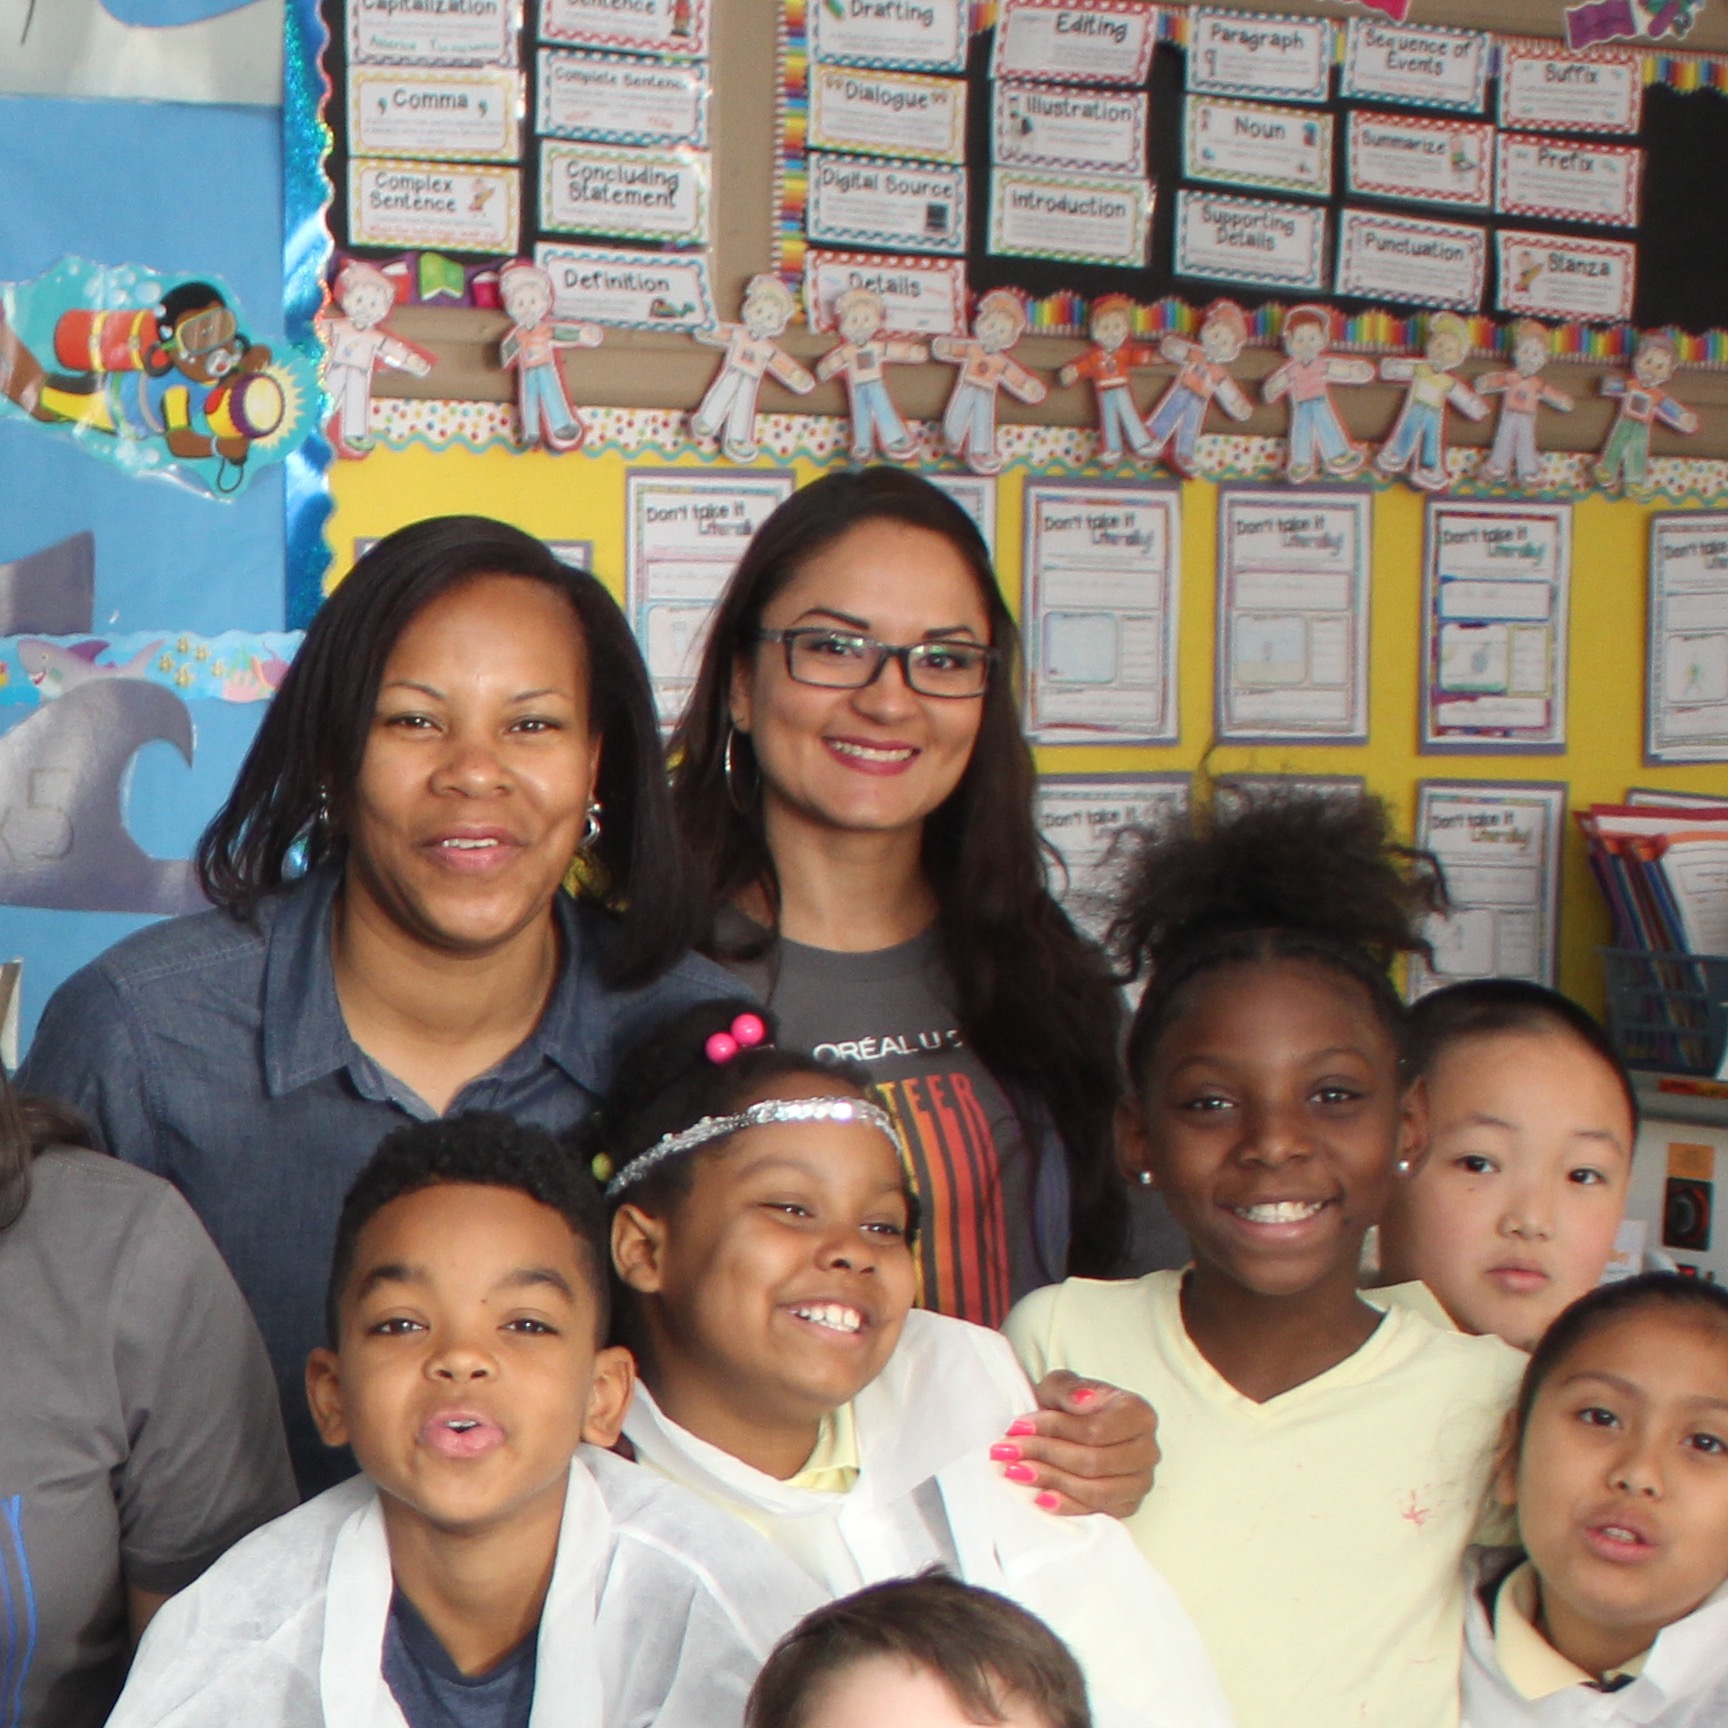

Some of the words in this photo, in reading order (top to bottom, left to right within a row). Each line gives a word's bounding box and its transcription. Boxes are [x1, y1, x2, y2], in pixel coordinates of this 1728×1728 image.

[1056, 12, 1128, 42] Editing
[1211, 23, 1304, 52] Paragraph
[1365, 29, 1448, 56] Sequence
[1456, 39, 1475, 58] of
[1386, 50, 1443, 75] Events
[1545, 62, 1600, 85] Suffix
[392, 88, 469, 110] Comma
[845, 81, 930, 112] Dialogue
[1026, 97, 1134, 122] Illustration
[1234, 114, 1286, 139] Noun
[1361, 128, 1447, 155] Summarize
[566, 159, 680, 194] Concluding
[1537, 151, 1596, 175] Prefix
[375, 171, 453, 195] Complex
[568, 181, 677, 208] Statement
[822, 166, 879, 194] Digital
[885, 174, 953, 198] Source
[370, 190, 457, 212] Sentence
[1012, 188, 1127, 219] Introduction
[1201, 204, 1295, 236] Supporting
[1215, 226, 1275, 252] Details
[1365, 230, 1464, 261] Punctuation
[1547, 252, 1611, 277] Stanza
[563, 269, 670, 293] Definition
[849, 270, 921, 298] Details
